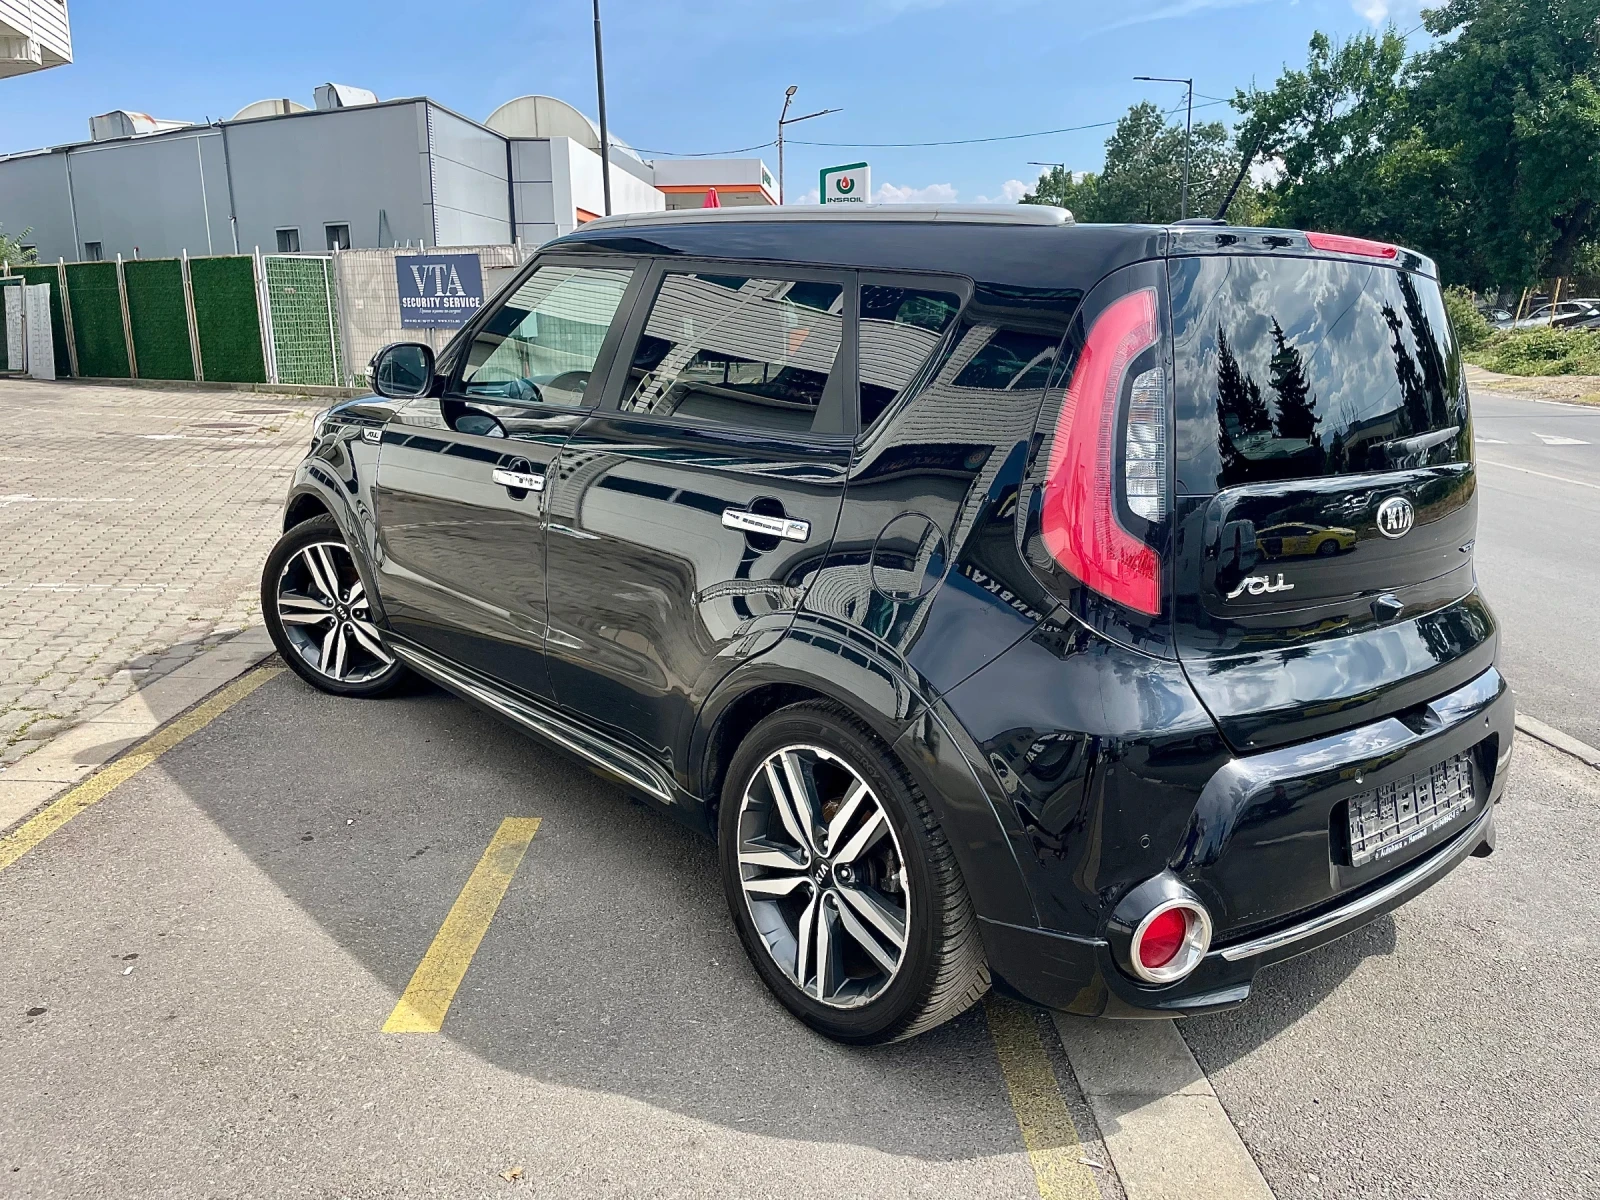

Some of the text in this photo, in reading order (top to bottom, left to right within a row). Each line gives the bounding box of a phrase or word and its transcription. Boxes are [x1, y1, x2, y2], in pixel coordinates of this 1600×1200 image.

[410, 264, 467, 297] VTA
[402, 297, 481, 308] SECURITY SERVICE
[1385, 506, 1412, 530] KIA
[1226, 573, 1295, 601] SOUL
[814, 863, 829, 885] KIA
